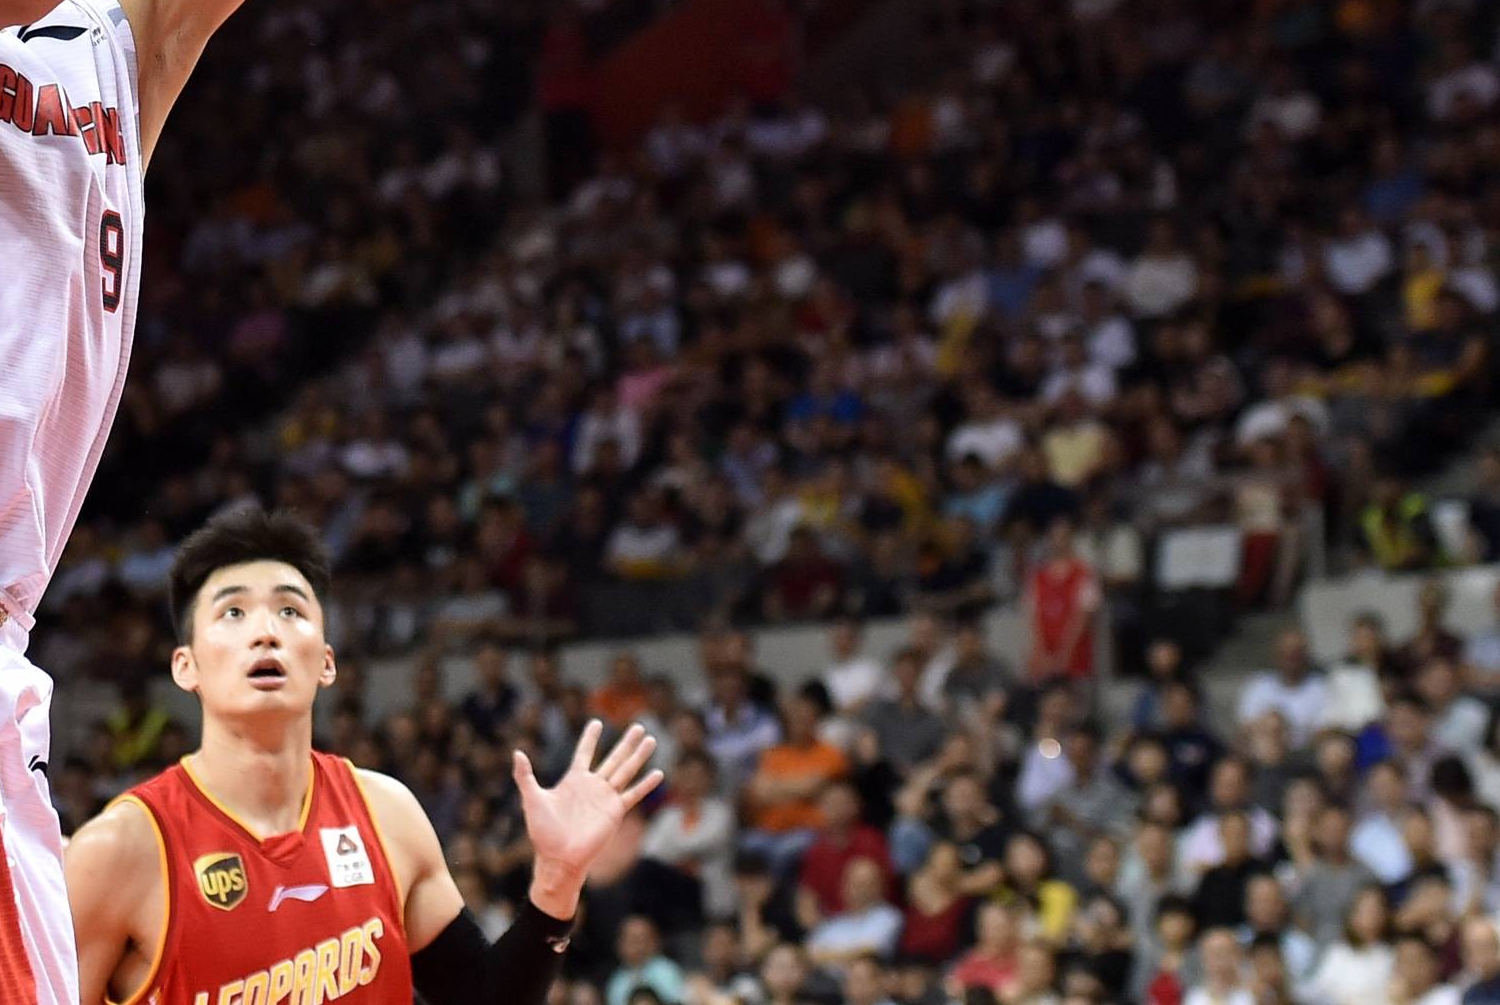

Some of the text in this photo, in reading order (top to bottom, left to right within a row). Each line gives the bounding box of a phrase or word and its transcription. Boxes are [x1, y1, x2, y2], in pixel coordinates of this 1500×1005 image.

[98, 208, 124, 315] 9
[203, 869, 244, 902] ups
[195, 917, 384, 1005] OPARDS
